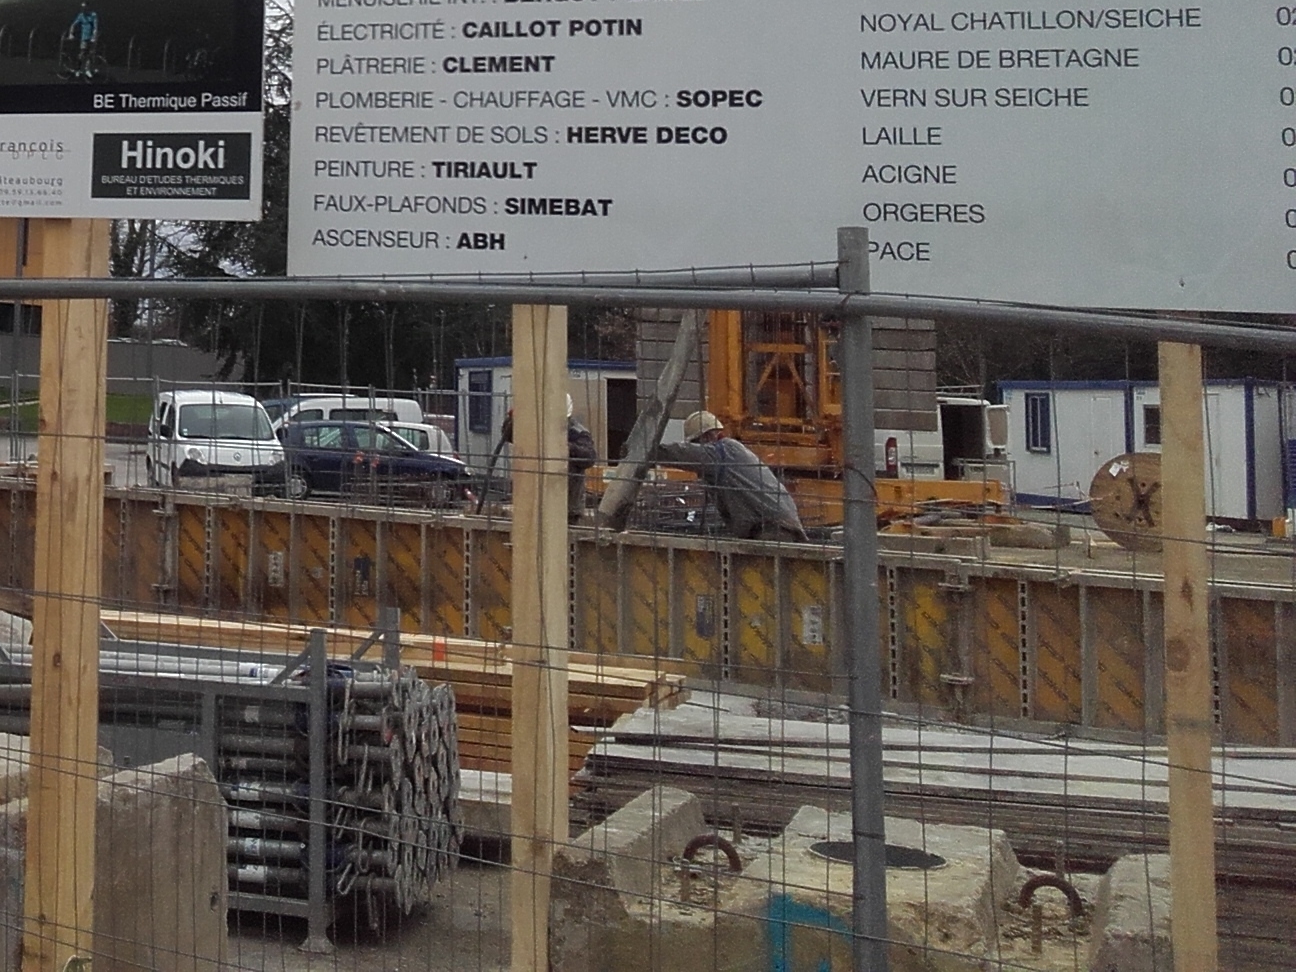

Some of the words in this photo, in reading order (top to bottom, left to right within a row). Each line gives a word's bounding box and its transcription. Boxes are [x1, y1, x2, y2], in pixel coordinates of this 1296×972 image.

[317, 22, 445, 42] ÉLECTRICITÉ
[462, 19, 562, 39] CAILLOT
[569, 18, 643, 37] POTIN
[316, 54, 425, 75] PLÂTRERIE
[442, 55, 556, 74] CLEMENT
[861, 50, 950, 70] MAURE
[957, 49, 991, 69] DE
[998, 47, 1140, 69] BRETAGNE
[93, 94, 115, 108] BE
[119, 93, 197, 111] Thermique
[201, 92, 248, 107] Passif
[315, 91, 434, 109] PLOMBERIE
[453, 90, 585, 109] CHAUFFAGE
[606, 89, 657, 109] VMC
[676, 89, 763, 108] SOPEC
[315, 122, 451, 143] REVÊTEMENT
[456, 126, 485, 144] DE
[490, 125, 548, 144] SOLS
[566, 126, 648, 144] HERVE
[656, 126, 728, 145] DECO
[121, 140, 225, 169] Hinoki
[101, 176, 137, 184] BUREAU
[139, 176, 183, 184] D'ETUDES
[184, 175, 244, 185] THERMIQUES
[314, 160, 415, 178] PEINTURE
[431, 161, 538, 180] TIRIAULT
[861, 164, 957, 185] ACIGNE
[126, 187, 138, 196] ET
[140, 187, 217, 197] ENVIRONNEMENT
[314, 194, 487, 215] FAUX-PLAFONDS
[504, 197, 613, 217] SIMEBAT
[862, 202, 986, 224] ORGERES
[311, 228, 439, 249] ASCENSEUR
[456, 232, 506, 251] ABH
